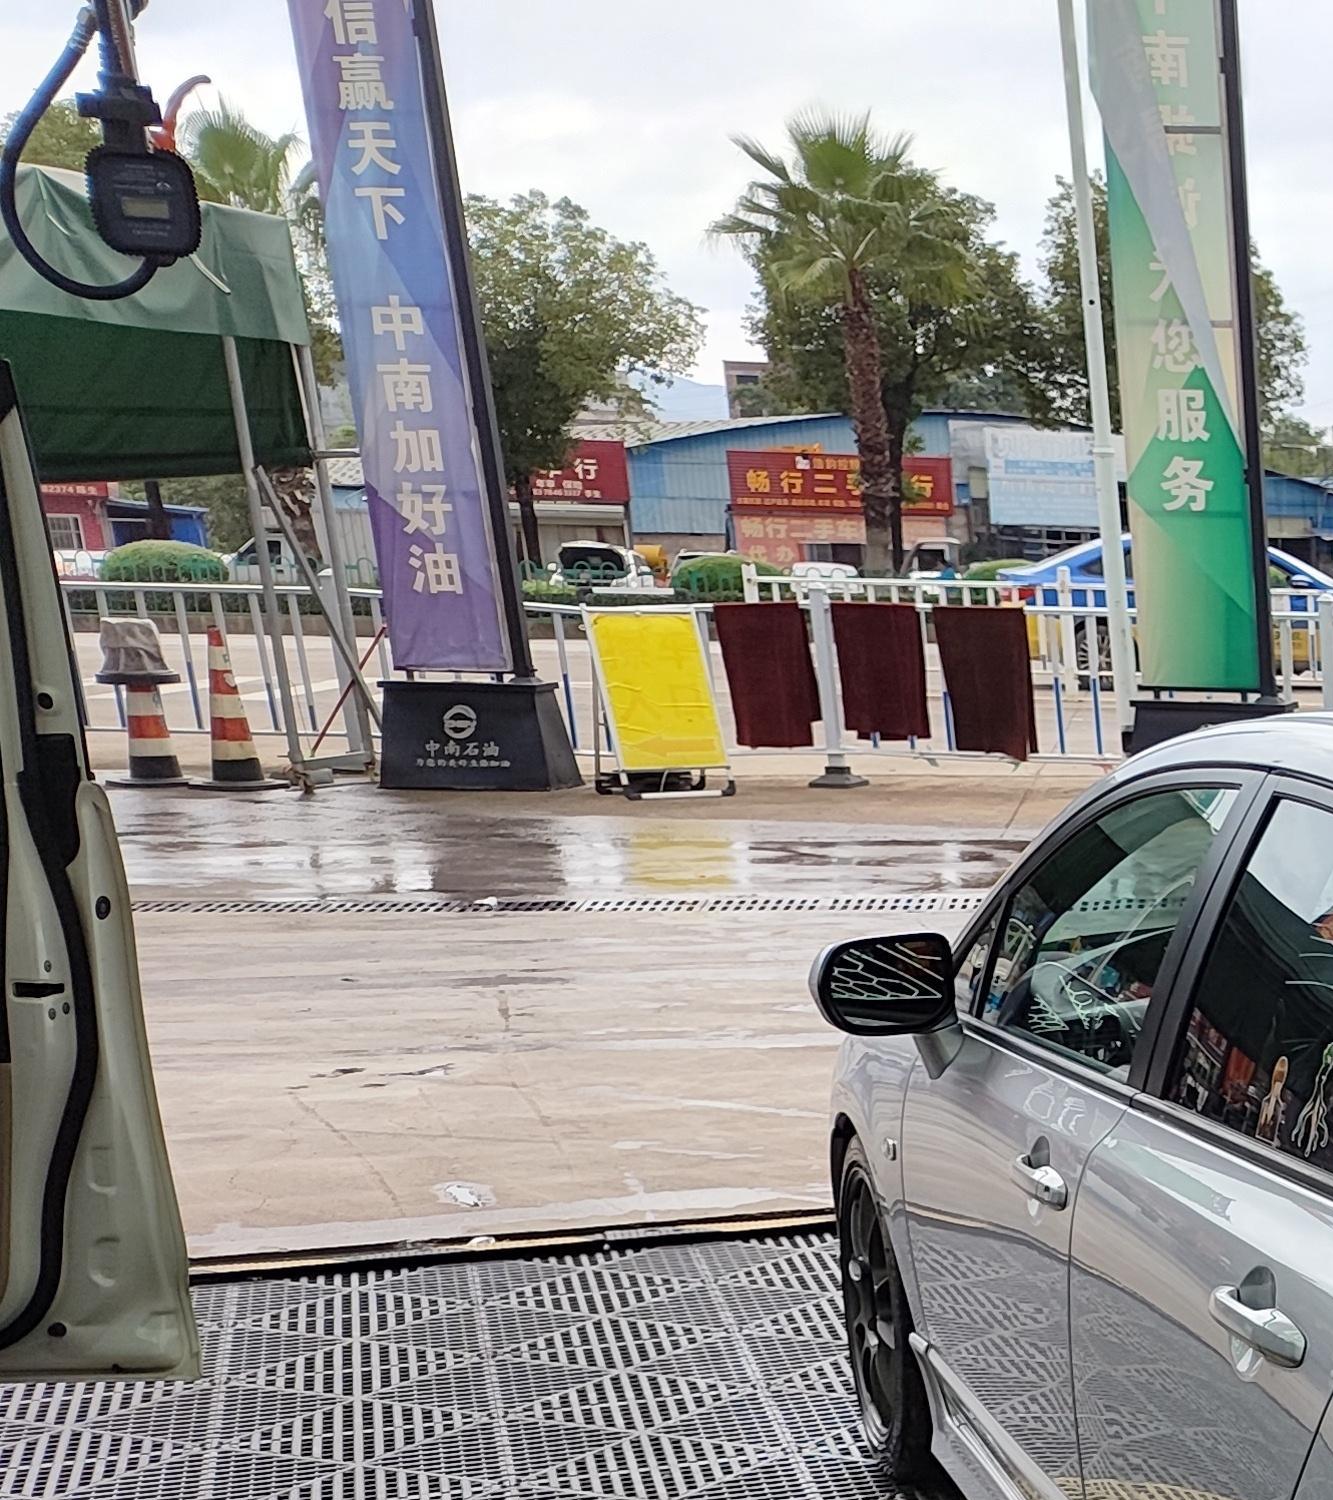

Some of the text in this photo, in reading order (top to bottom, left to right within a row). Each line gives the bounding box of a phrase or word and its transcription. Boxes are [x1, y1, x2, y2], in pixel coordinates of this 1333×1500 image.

[324, 0, 463, 595] 信赢天下 中南加好油
[425, 740, 499, 757] 中南石油
